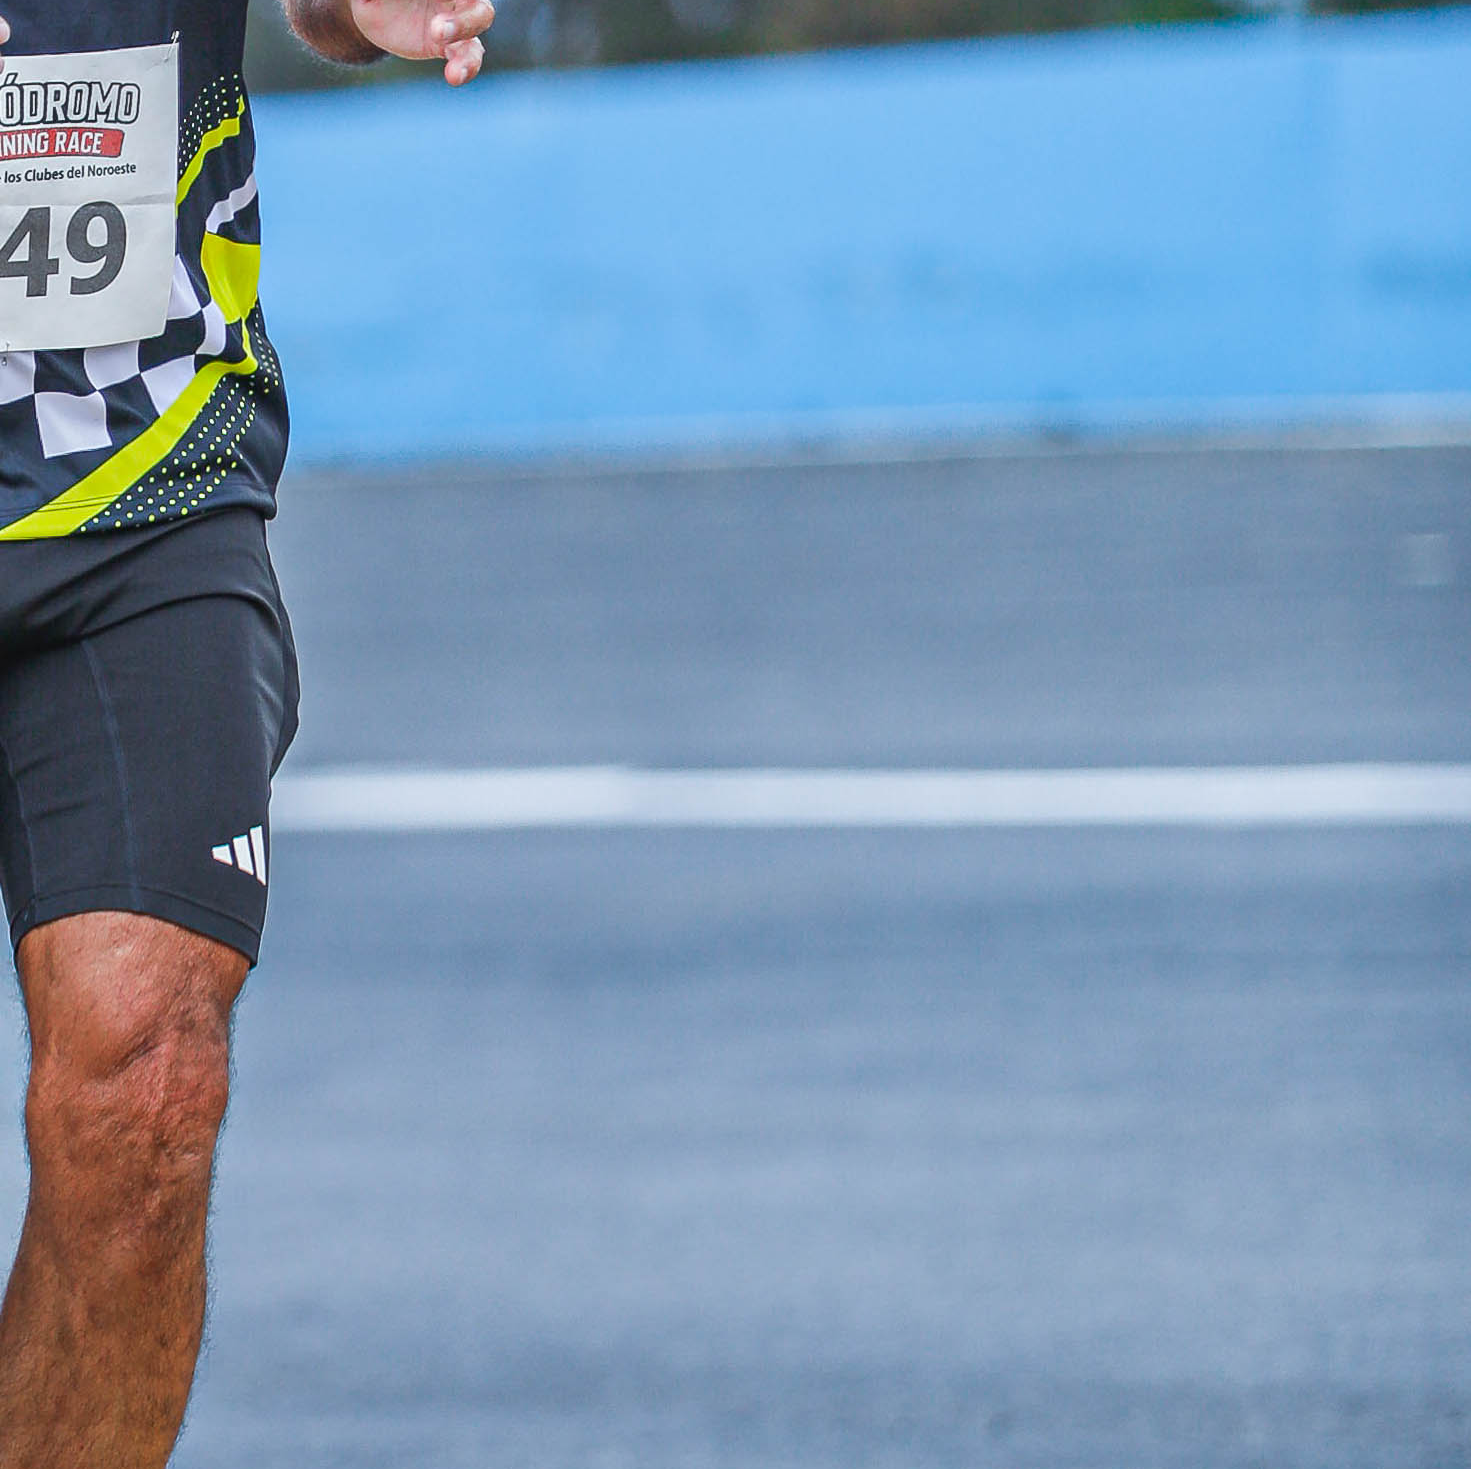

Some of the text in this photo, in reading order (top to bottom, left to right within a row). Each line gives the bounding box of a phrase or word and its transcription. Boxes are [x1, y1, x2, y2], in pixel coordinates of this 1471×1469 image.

[54, 131, 104, 154] RACE
[4, 170, 22, 183] los
[25, 168, 64, 181] Clubes
[66, 165, 85, 179] del
[87, 163, 137, 177] Noroeste
